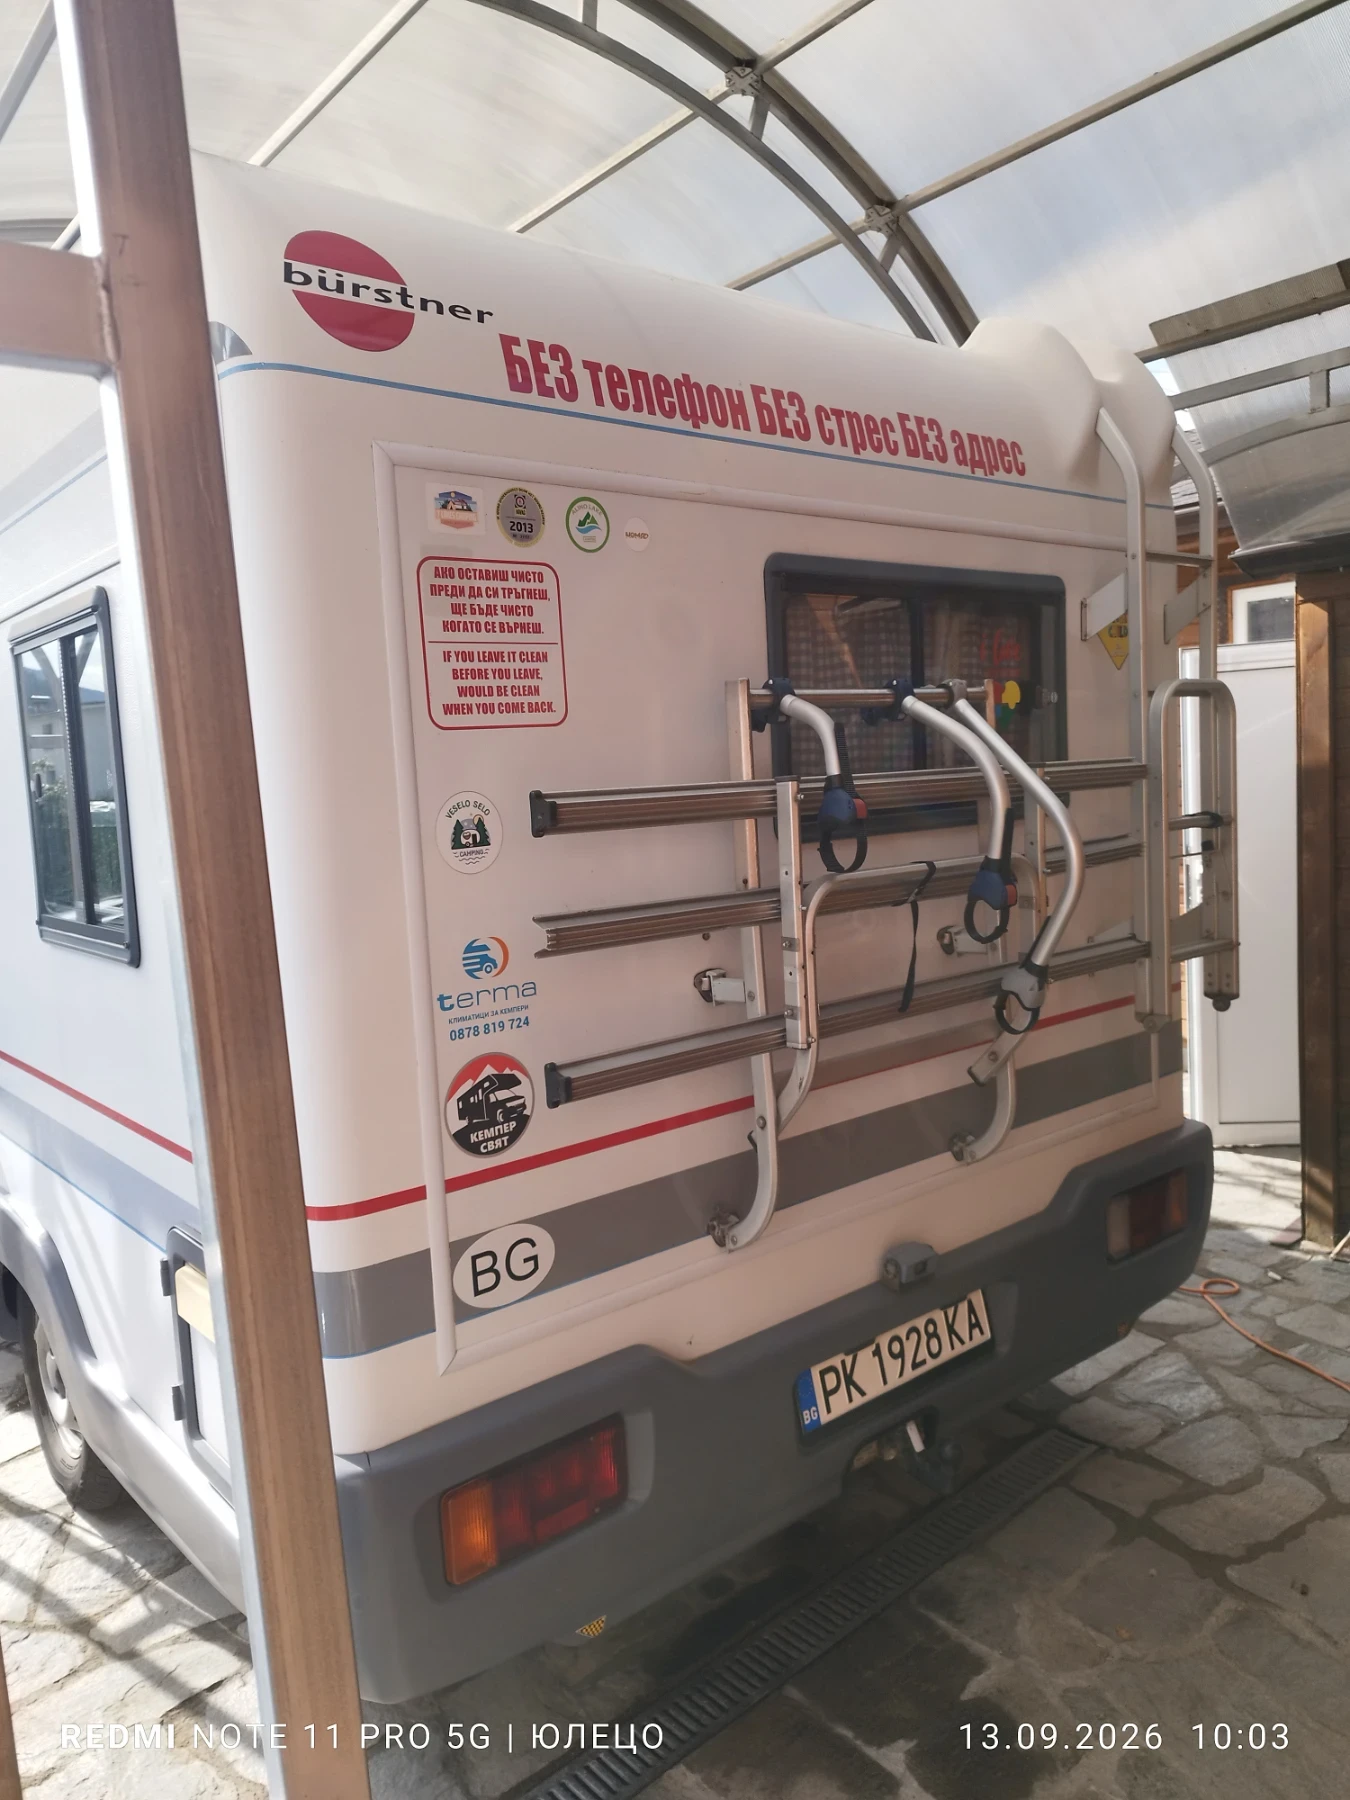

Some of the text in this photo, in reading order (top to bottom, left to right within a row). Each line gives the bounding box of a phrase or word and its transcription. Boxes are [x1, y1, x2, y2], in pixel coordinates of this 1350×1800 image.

[284, 261, 494, 324] bürstner
[499, 333, 1027, 477] БЕЗ телефон БЕЗ стрес БЕЗ адрес
[509, 521, 534, 533] 2013
[434, 566, 544, 583] АКО ОСТАВИШ ЧИСТО
[430, 584, 550, 601] ПРЕДИ ДА СИ ТРЪГНЕШ,
[451, 602, 534, 617] ЩЕ БЪДЕ ЧИСТО
[442, 620, 544, 634] КОГАТО СЕ ВЪРНЕШ.
[443, 650, 548, 663] IF YOU LEAVE IT CLEAN
[452, 668, 543, 681] BEFORE YOU LEAVE,
[457, 685, 540, 697] WOULD BE CLEAN
[442, 701, 556, 715] WHEN YOU COME BACK.
[445, 799, 491, 819] VESELO SELO
[437, 981, 537, 1012] terma
[448, 1004, 529, 1025] КЛИМАТИЦИ ЗА КЕМПЕРИ
[449, 1015, 530, 1041] 0878 819 724
[470, 1121, 517, 1143] КЕМПЕР
[480, 1135, 510, 1153] СВЯТ
[471, 1237, 539, 1298] BG
[819, 1354, 867, 1415] PK
[871, 1317, 942, 1386] 1928
[802, 1406, 819, 1425] BG
